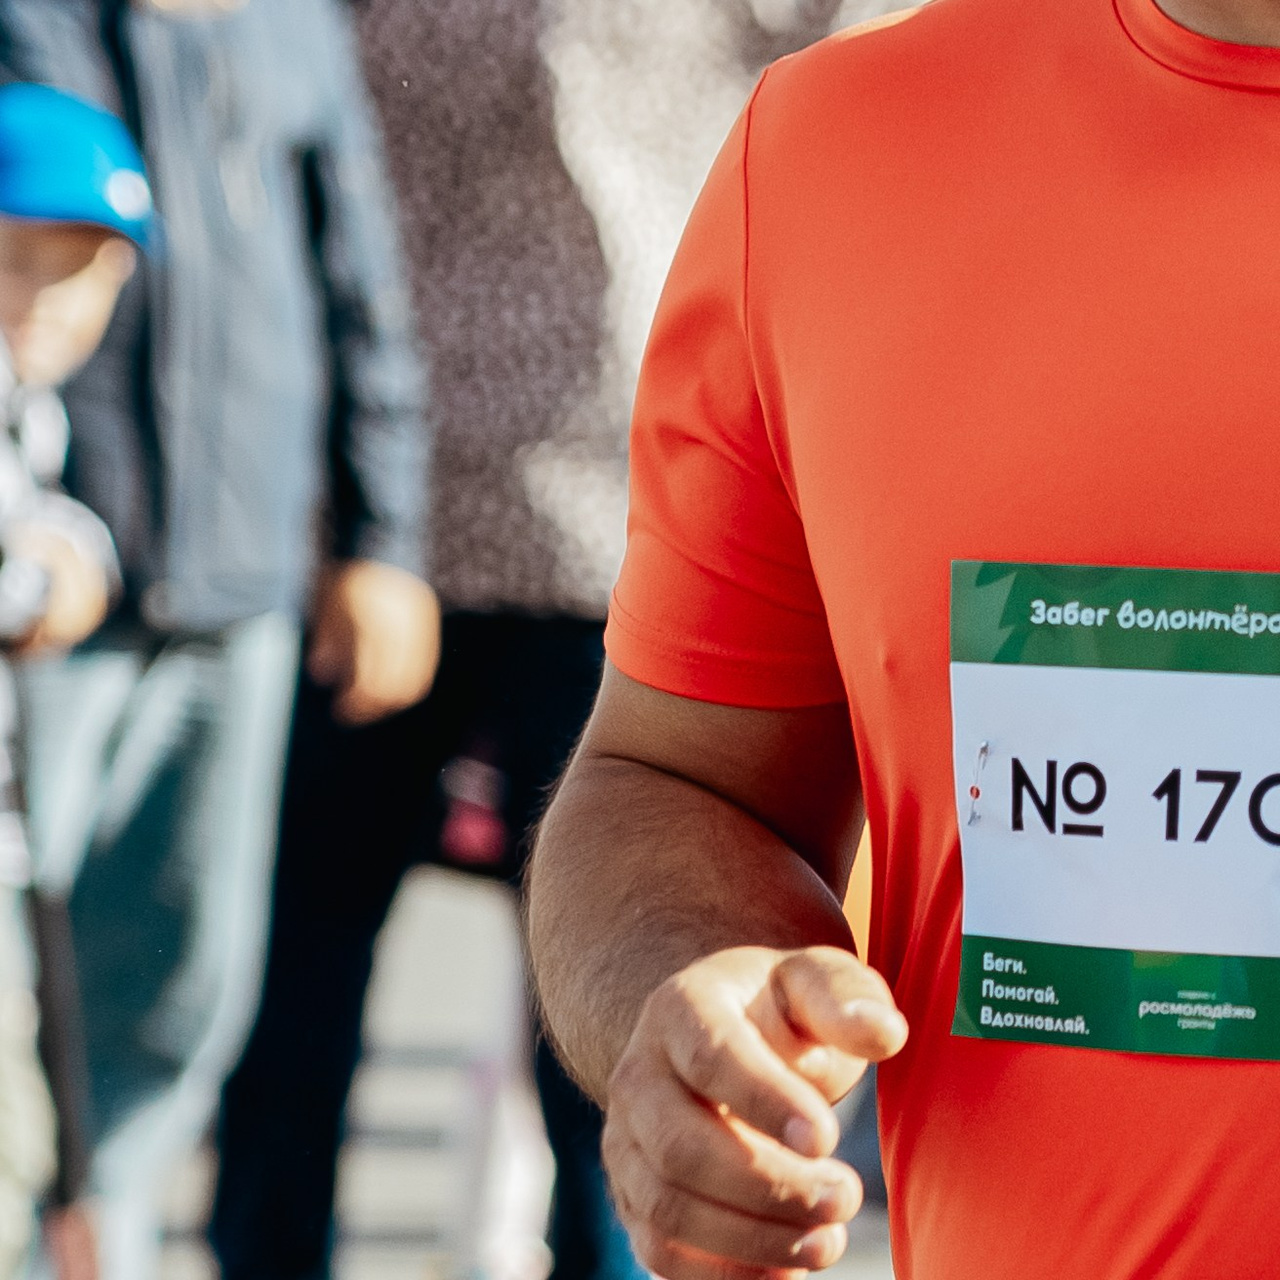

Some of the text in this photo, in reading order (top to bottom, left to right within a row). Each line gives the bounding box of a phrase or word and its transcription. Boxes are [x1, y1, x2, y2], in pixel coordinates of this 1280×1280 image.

[1029, 598, 1111, 628] Забег
[982, 951, 1028, 976] Беги.
[981, 978, 1060, 1006] Помогай.
[979, 1005, 1091, 1036] Вдохновляй.
